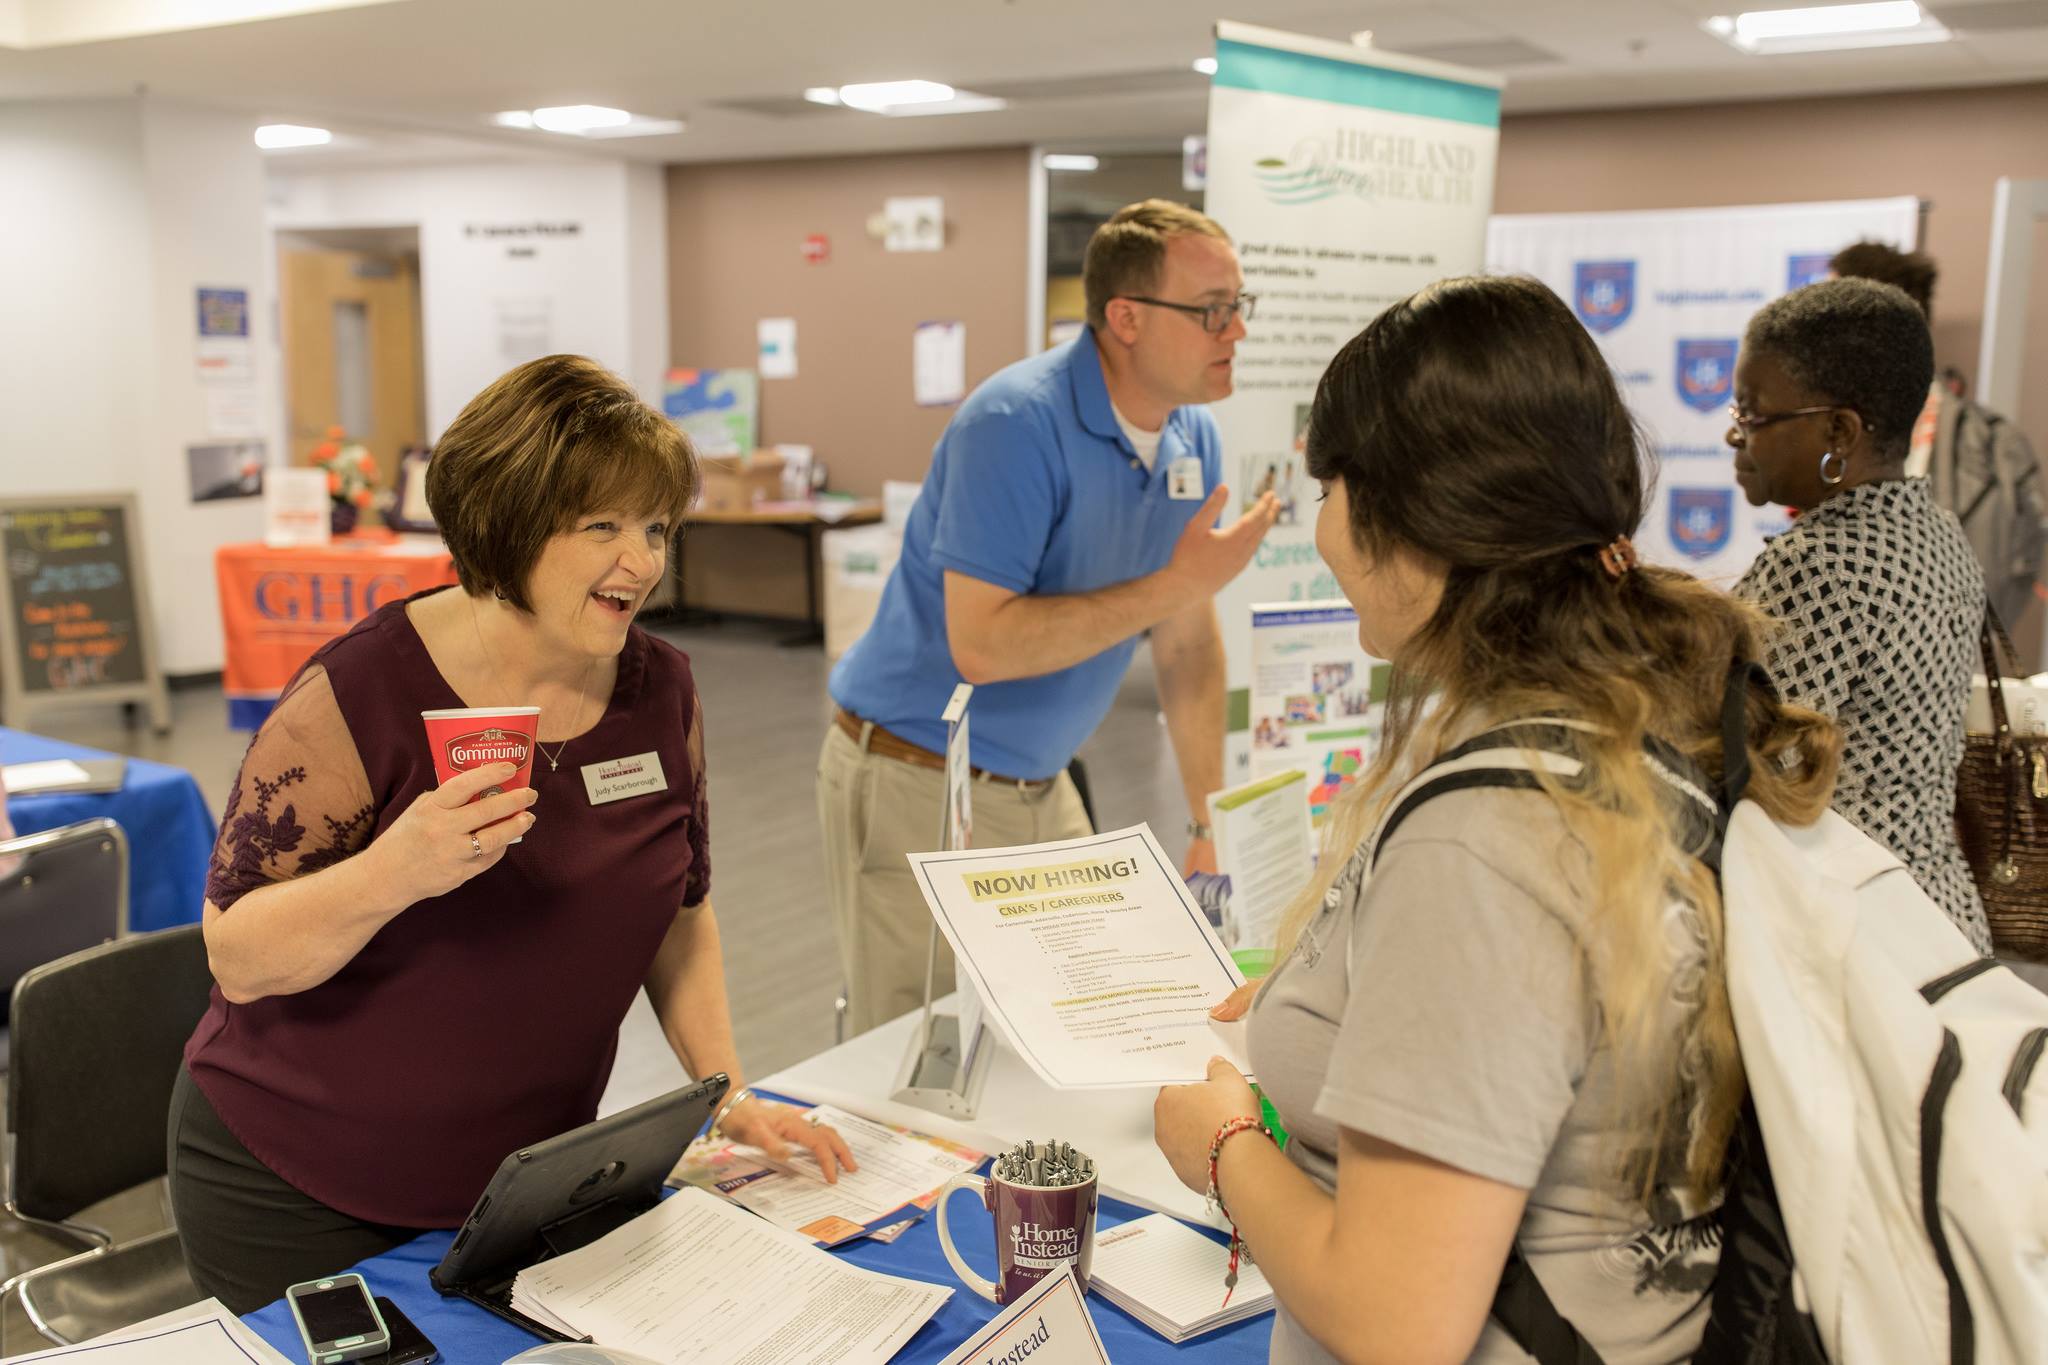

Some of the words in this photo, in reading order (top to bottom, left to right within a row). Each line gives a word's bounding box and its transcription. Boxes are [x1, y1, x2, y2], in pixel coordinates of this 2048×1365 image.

[255, 571, 409, 623] GHC
[452, 743, 528, 764] Community
[595, 787, 611, 797] Judy
[612, 777, 658, 792] Scarborough
[973, 873, 1036, 897] NOW
[1044, 857, 1139, 888] HIRING!
[999, 903, 1038, 916] CNA'S
[1049, 892, 1125, 909] CAREGIVERS
[1022, 1221, 1076, 1242] Home
[1014, 1234, 1078, 1258] Instead
